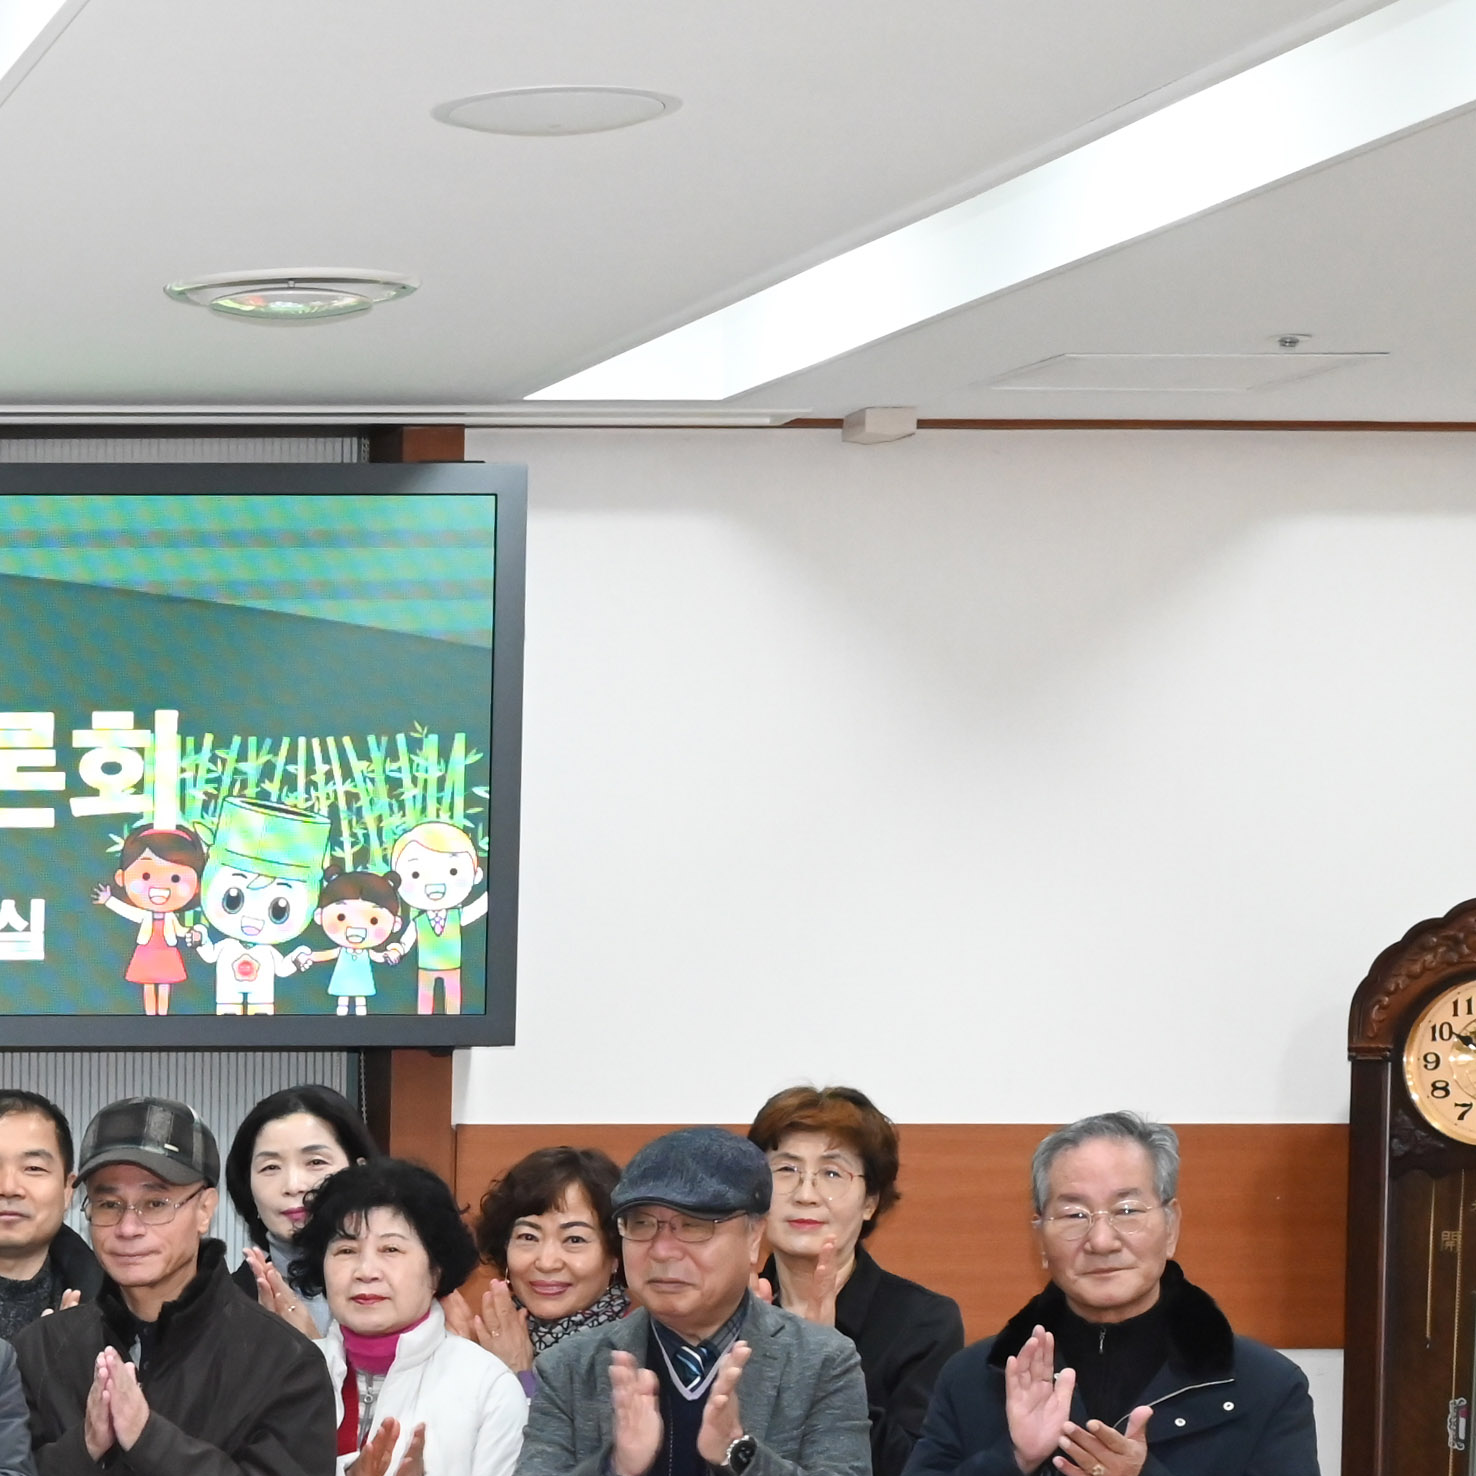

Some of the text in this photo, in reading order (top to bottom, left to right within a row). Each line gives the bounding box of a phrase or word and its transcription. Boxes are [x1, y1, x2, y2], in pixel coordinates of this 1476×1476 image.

[1452, 997, 1473, 1017] 11
[1431, 1021, 1453, 1042] 10
[1422, 1051, 1441, 1071] 9
[1430, 1079, 1451, 1099] 8
[1454, 1102, 1474, 1121] 7
